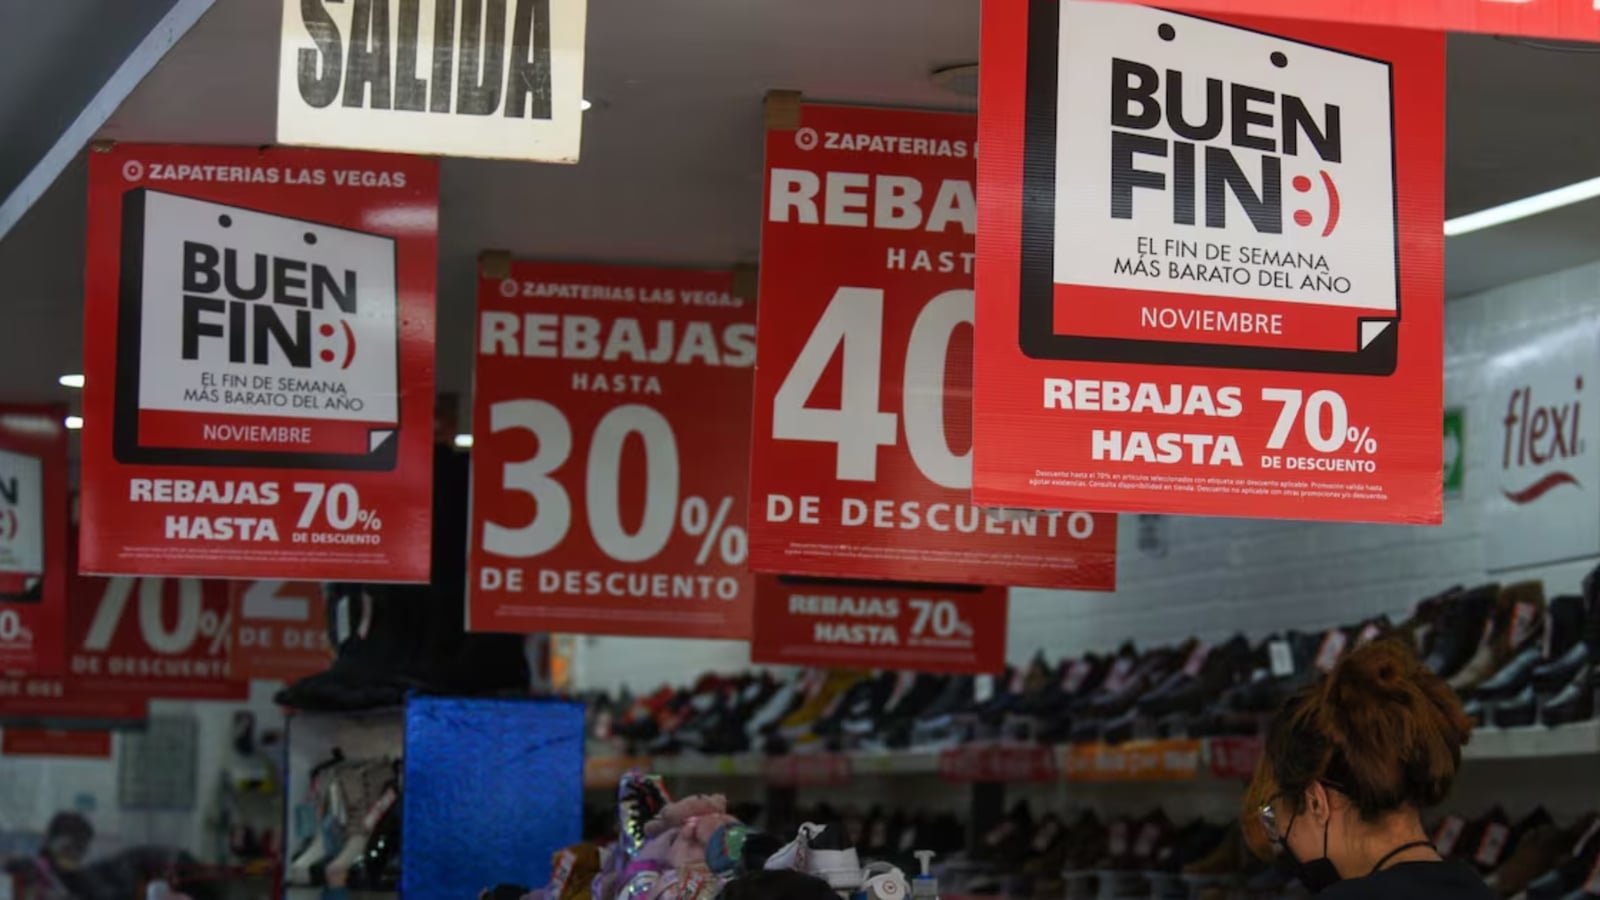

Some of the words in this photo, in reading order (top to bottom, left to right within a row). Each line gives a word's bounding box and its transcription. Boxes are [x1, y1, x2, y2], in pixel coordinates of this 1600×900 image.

[297, 0, 552, 120] SALIDA
[1110, 57, 1342, 164] BUEN
[825, 132, 968, 158] ZAPATERIAS
[149, 163, 279, 185] ZAPATERIAS
[285, 168, 326, 186] LAS
[334, 169, 406, 188] VEGAS
[769, 167, 976, 235] REBA
[887, 248, 975, 275] HAST
[1137, 236, 1162, 256] EL
[1165, 238, 1198, 259] FIN
[1204, 242, 1231, 263] DE
[1238, 246, 1330, 271] SEMANA
[182, 240, 357, 314] BUEN
[1114, 250, 1161, 278] MÁS
[1167, 260, 1251, 286] BARATO
[1258, 269, 1294, 290] DEL
[1299, 267, 1351, 294] AÑO
[523, 281, 635, 302] ZAPATERIAS
[639, 287, 676, 305] LAS
[1141, 307, 1283, 335] NOVIEMBRE
[480, 312, 756, 368] REBAJAS
[184, 383, 221, 405] MÁS
[224, 390, 288, 409] BARATO
[292, 393, 322, 411] DEL
[325, 391, 364, 412] AÑO
[201, 372, 220, 388] EL
[223, 373, 249, 390] FIN
[253, 375, 275, 391] DE
[278, 376, 347, 395] SEMANA
[572, 372, 662, 395] HASTA
[1043, 378, 1243, 418] REBAJAS
[203, 424, 312, 444] NOVIEMBRE
[1261, 387, 1377, 455] 70%
[1503, 374, 1584, 469] flexi
[1091, 430, 1243, 467] HASTA
[1261, 455, 1282, 469] DE
[1286, 456, 1376, 473] DESCUENTO
[130, 478, 280, 506] REBAJAS
[293, 482, 382, 531] 70%
[165, 514, 279, 542] HASTA
[766, 494, 820, 524] DE
[842, 498, 1095, 539] DESCUENTO
[292, 533, 309, 544] DE
[312, 533, 381, 546] DESCUENTO
[480, 568, 523, 592] DE
[538, 571, 739, 601] DESCUENTO
[788, 594, 899, 618] REBAJAS
[814, 622, 899, 645] HASTA
